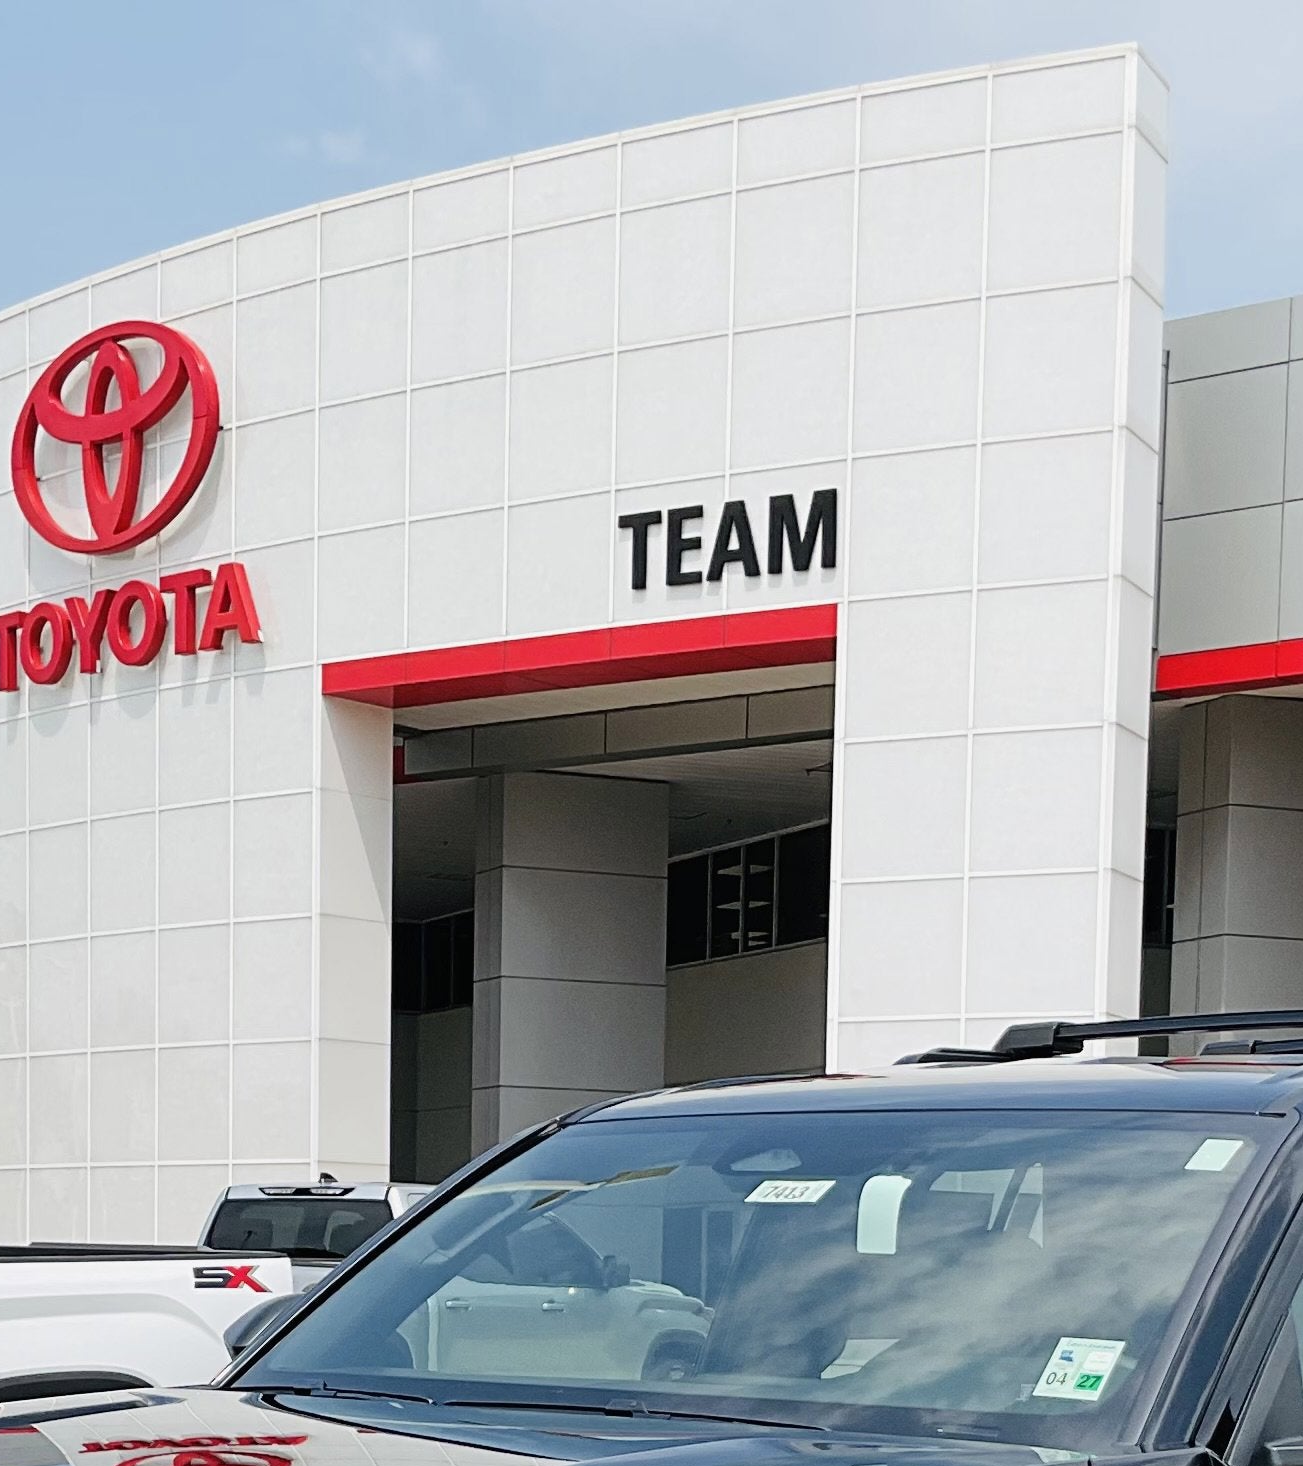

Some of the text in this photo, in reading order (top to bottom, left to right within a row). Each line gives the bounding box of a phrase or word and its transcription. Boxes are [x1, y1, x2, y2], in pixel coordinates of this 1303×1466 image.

[618, 488, 838, 590] TEAM
[193, 1264, 273, 1292] SX
[1046, 1372, 1103, 1388] 04 27
